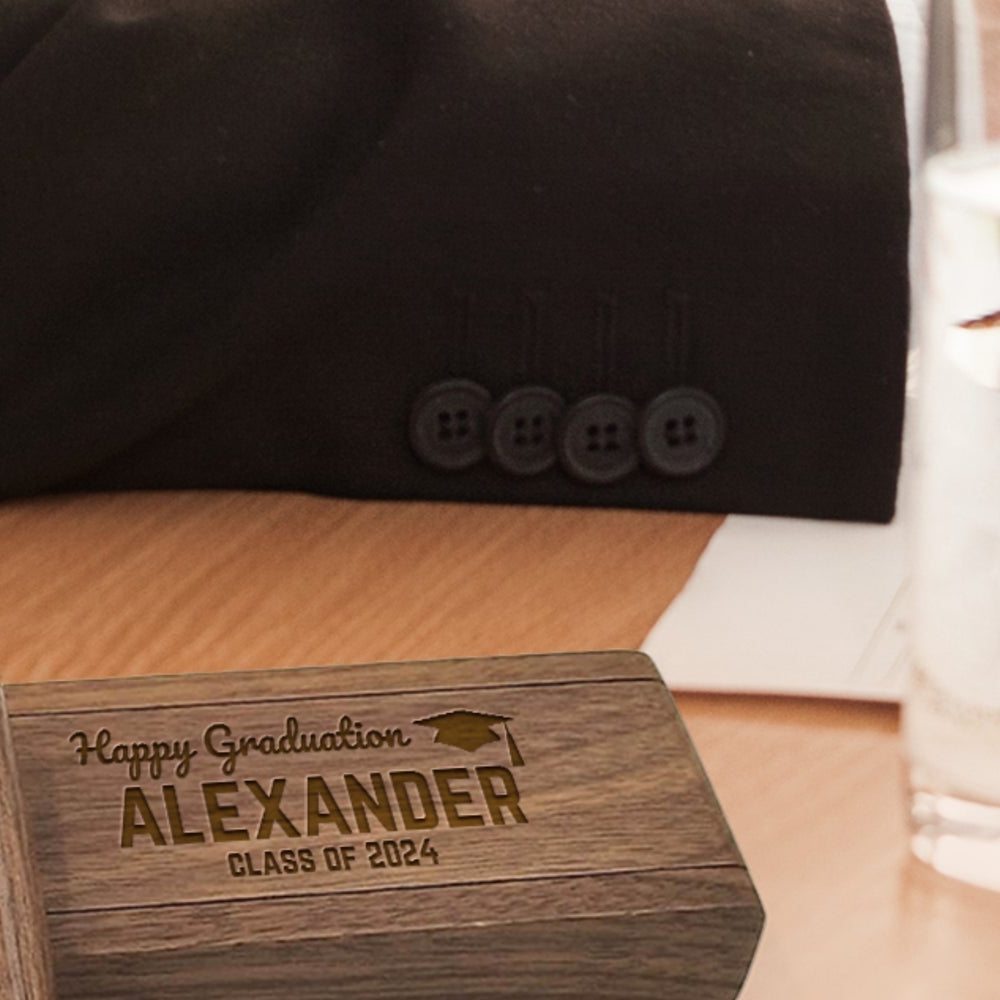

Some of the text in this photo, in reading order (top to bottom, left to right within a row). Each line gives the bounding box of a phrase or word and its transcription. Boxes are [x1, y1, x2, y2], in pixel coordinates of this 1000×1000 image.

[69, 716, 412, 781] Happy Graduation
[120, 765, 529, 848] ALEXANDER
[228, 838, 440, 878] CLASS OF 2024
